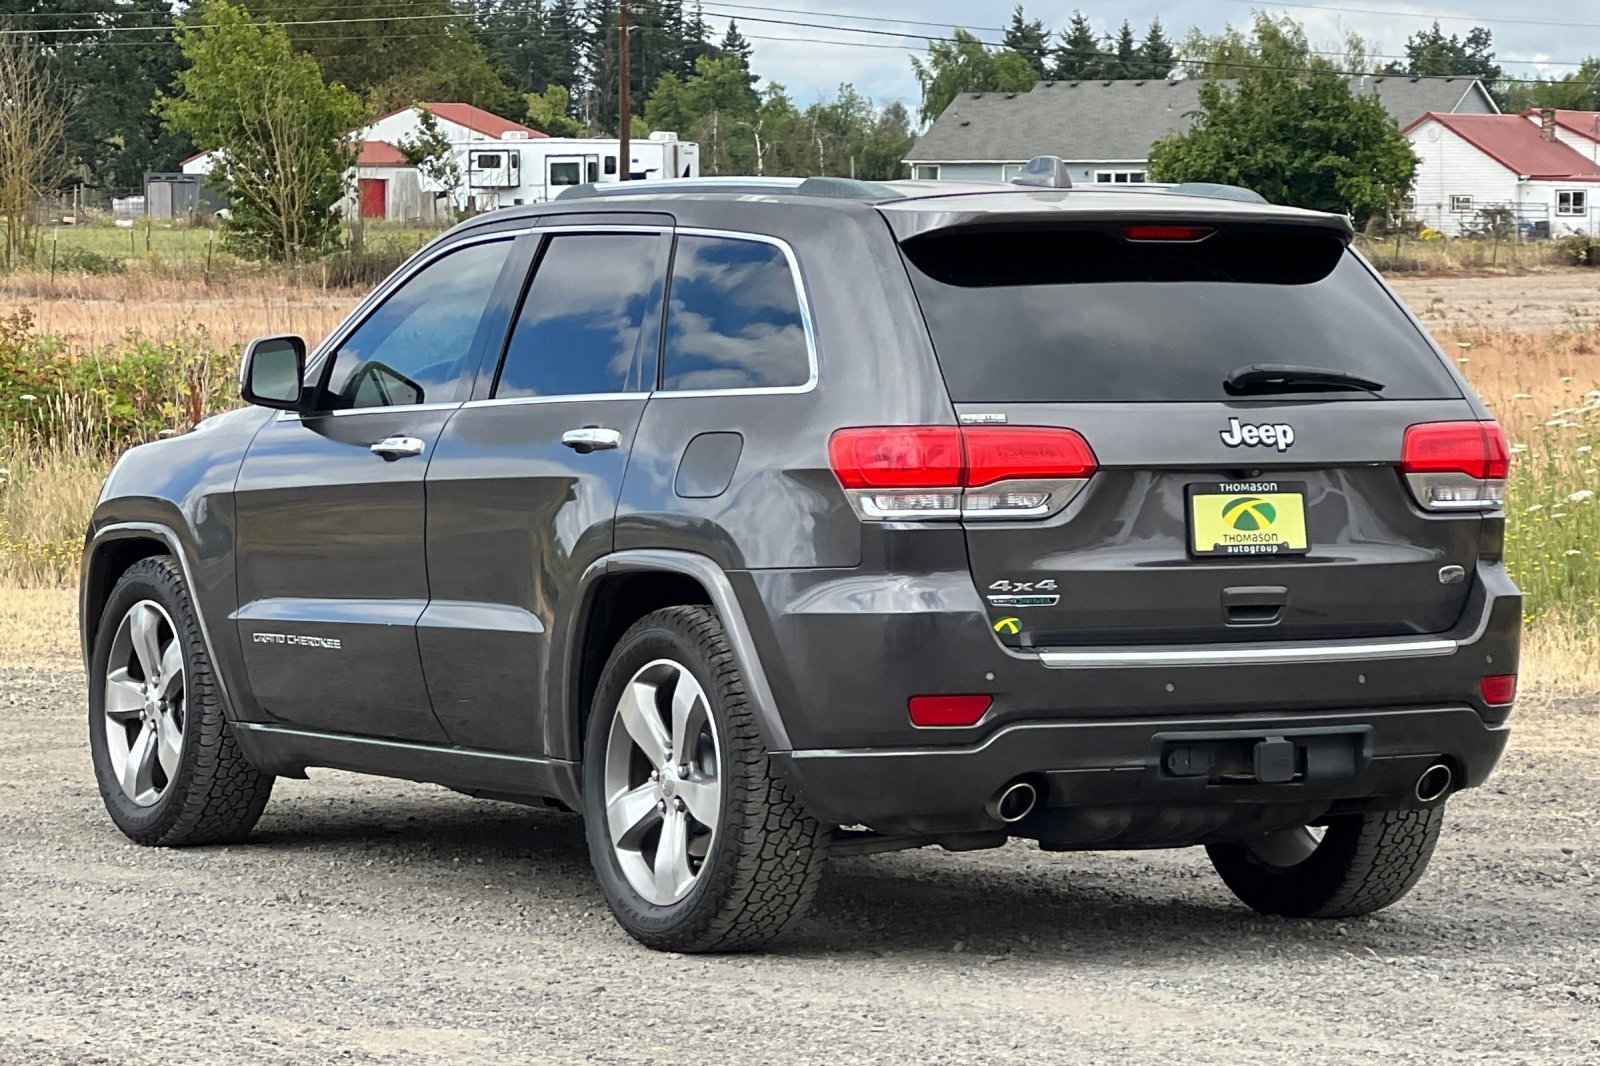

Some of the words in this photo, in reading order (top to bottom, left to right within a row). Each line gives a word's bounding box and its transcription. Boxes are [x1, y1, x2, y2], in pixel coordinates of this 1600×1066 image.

[1219, 417, 1295, 452] Jeep
[1227, 544, 1278, 554] autogroup
[988, 579, 1058, 592] 4x4
[252, 632, 286, 643] GRAND
[286, 634, 341, 649] CHEROKEE
